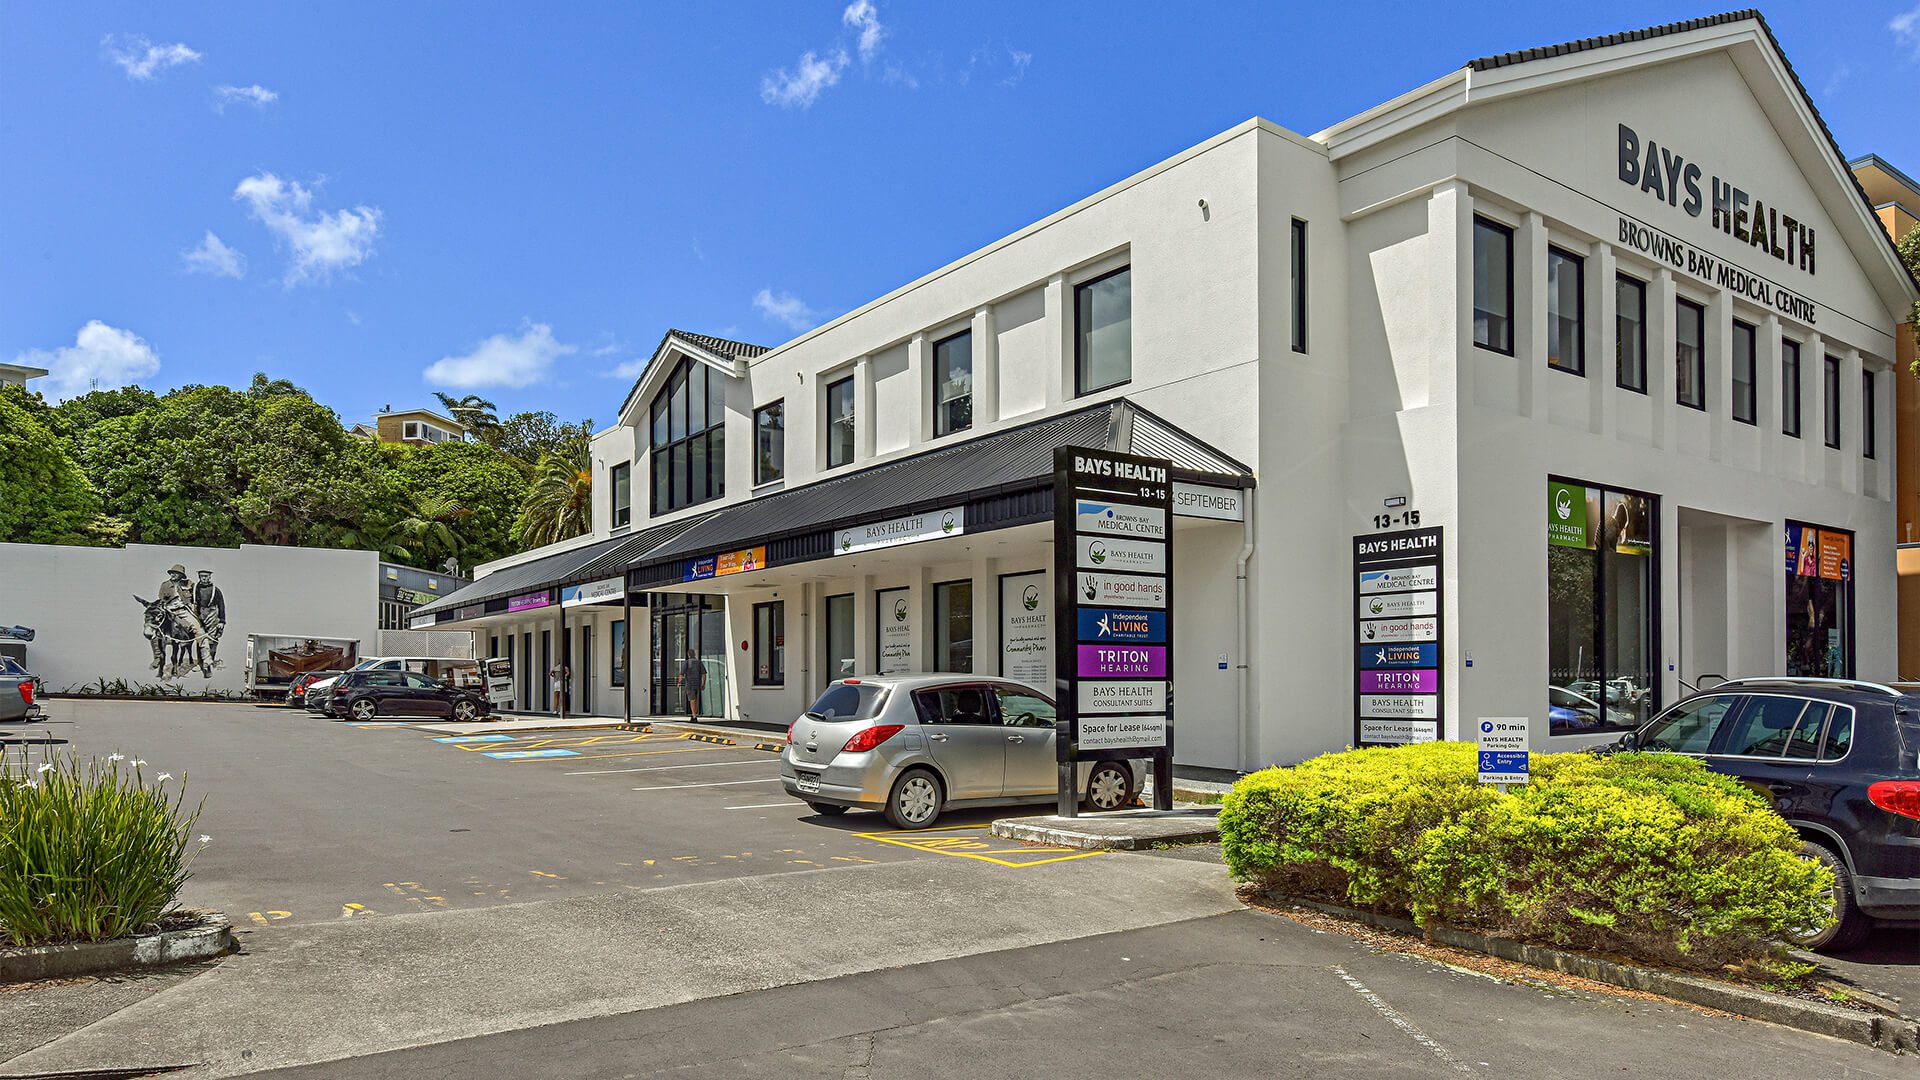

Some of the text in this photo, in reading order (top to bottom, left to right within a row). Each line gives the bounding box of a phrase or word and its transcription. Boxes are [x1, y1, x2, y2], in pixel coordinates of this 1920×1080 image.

[1618, 123, 1816, 276] BAYS HEALTH
[1618, 217, 1816, 325] BROWNS BAY MEDICAL CENTRE
[1075, 456, 1166, 483] BAYS HEALTH
[1178, 492, 1236, 511] SEPTEMBER
[1116, 514, 1138, 522] BROWNS
[866, 518, 923, 538] BAYS HEALTH
[1098, 520, 1163, 534] MEDICAL CENTRE
[1560, 525, 1582, 535] HEALTH
[1359, 535, 1436, 554] BAYS HEALTH
[698, 564, 713, 573] LIVING
[1104, 580, 1163, 593] in good hands
[1377, 578, 1434, 589] MEDICAL CENTRE
[1011, 616, 1025, 624] BAYS
[1112, 621, 1148, 632] LIVING
[1390, 624, 1408, 633] good
[1410, 622, 1434, 631] hands
[1098, 650, 1148, 663] TRITON
[1100, 664, 1149, 672] HEARING
[1376, 673, 1420, 682] TRITON
[1094, 687, 1152, 696] BAYS HEALTH
[1082, 724, 1105, 734] Space
[1107, 724, 1117, 732] for
